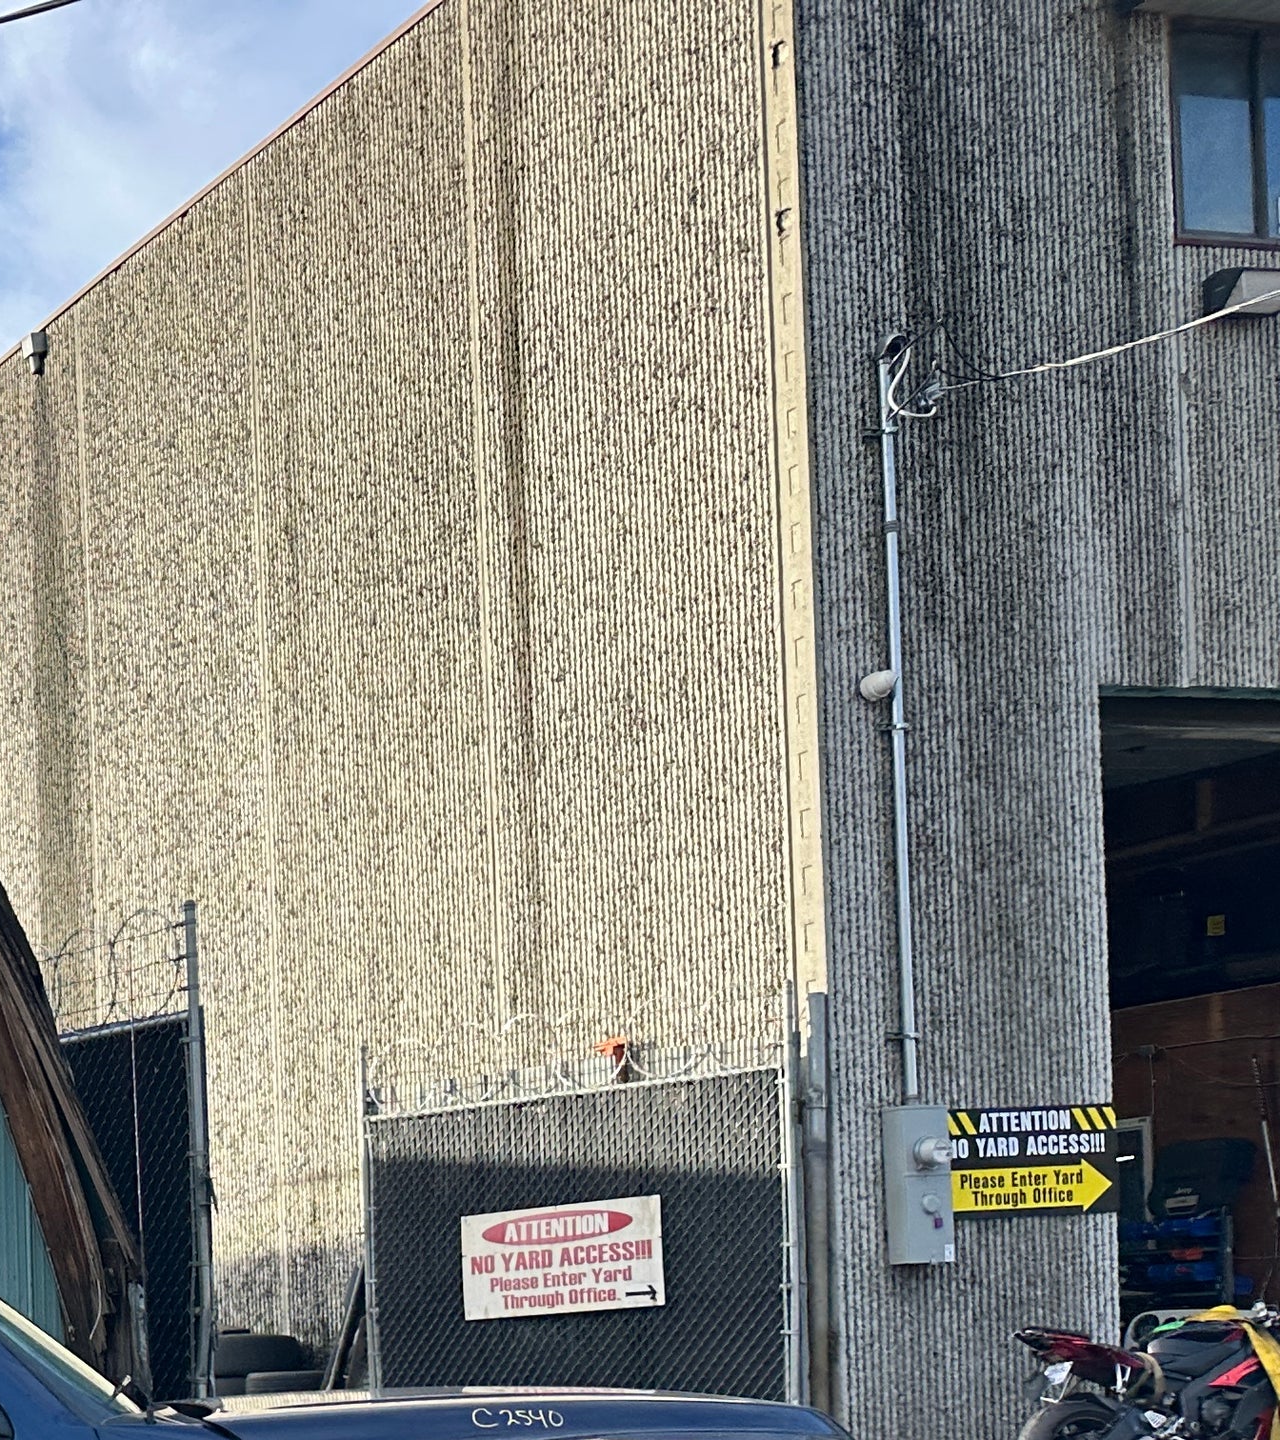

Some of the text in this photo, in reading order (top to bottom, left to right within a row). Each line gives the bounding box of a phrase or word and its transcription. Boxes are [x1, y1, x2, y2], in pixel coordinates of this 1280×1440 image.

[979, 1108, 1072, 1133] ATTENTION
[975, 1136, 1020, 1158] YARD
[1026, 1132, 1106, 1156] ACCESS!!!
[959, 1168, 1084, 1190] Please Enter Yard
[971, 1187, 1073, 1207] Through Office
[503, 1211, 611, 1243] ATTENTION
[470, 1239, 653, 1275] NO YARD ACCESS!!!
[490, 1265, 633, 1293] Please Enter Yard
[502, 1291, 565, 1310] Through
